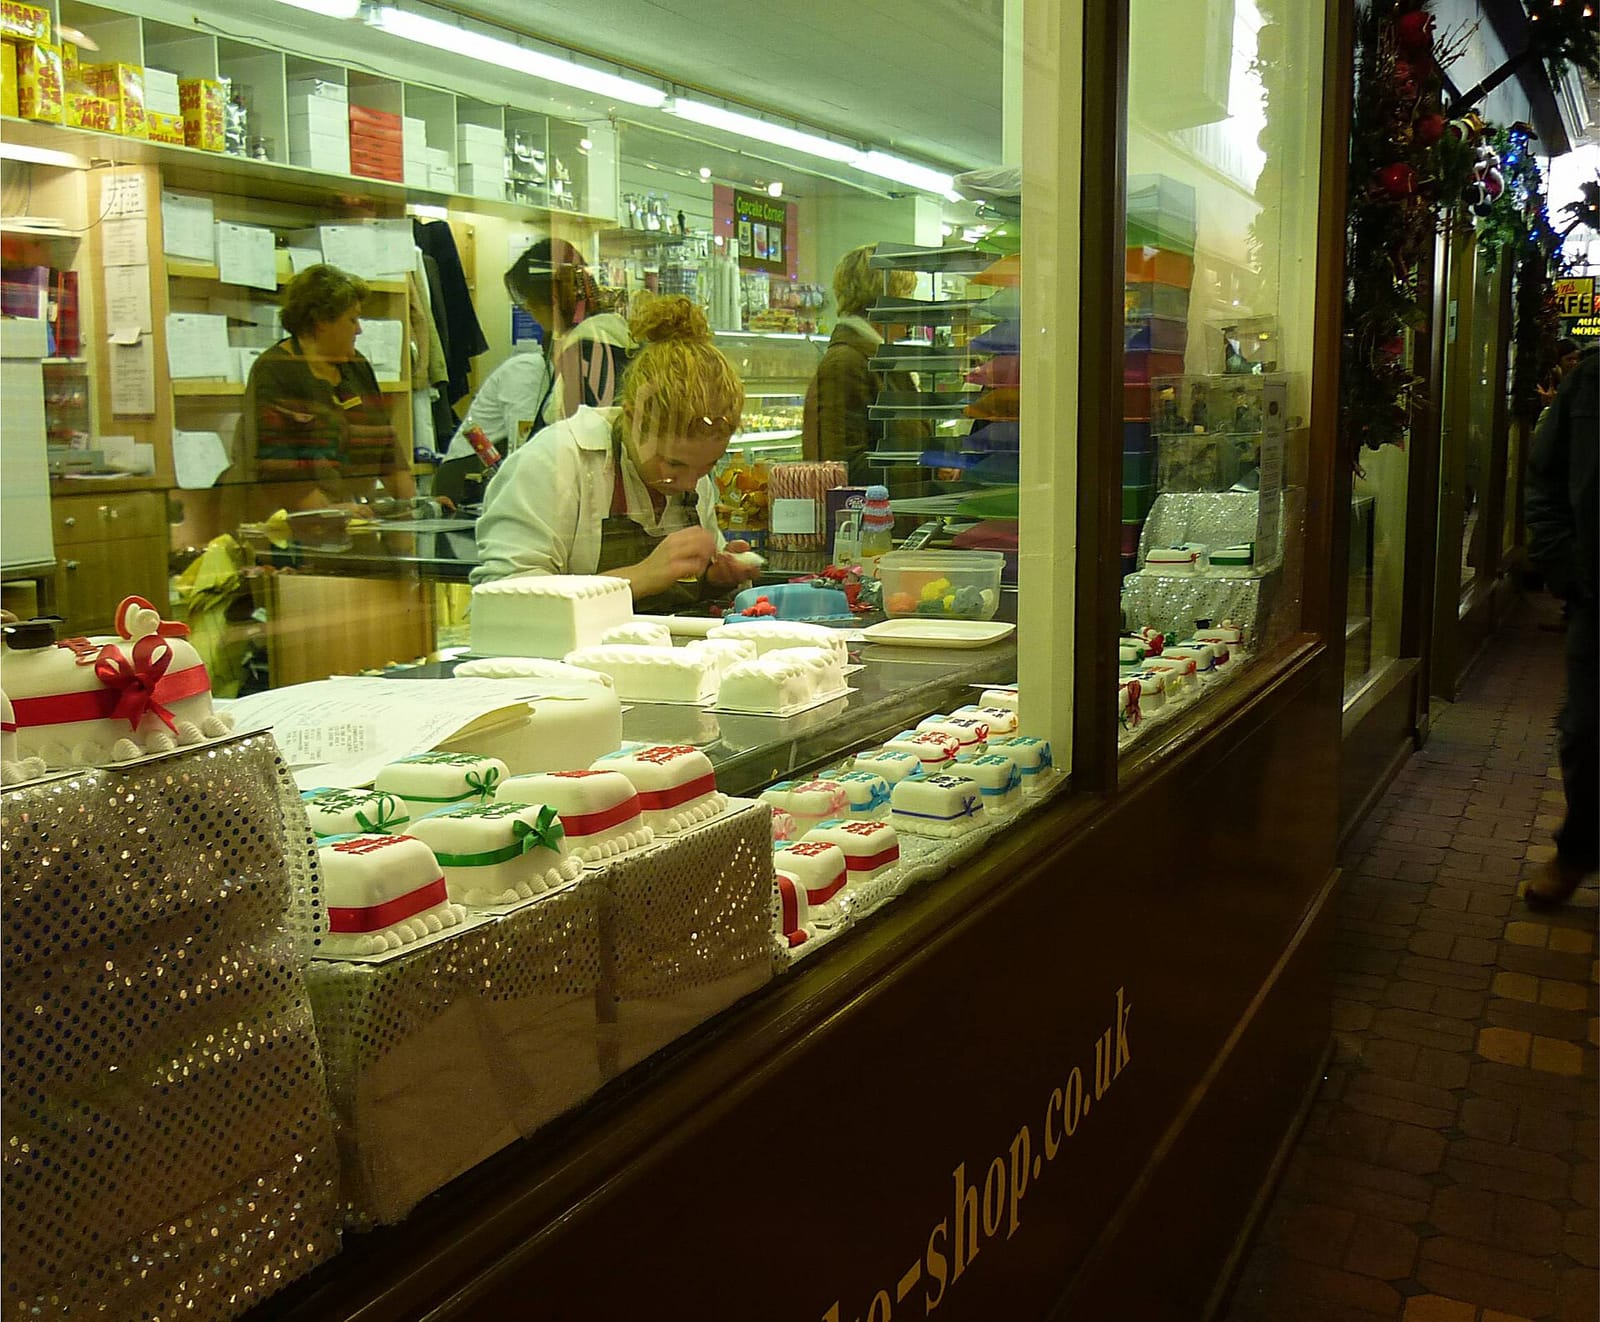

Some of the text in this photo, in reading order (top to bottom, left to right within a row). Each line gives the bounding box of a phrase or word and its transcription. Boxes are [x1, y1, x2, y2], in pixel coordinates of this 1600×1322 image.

[1, 2, 43, 21] UGAR
[74, 97, 117, 115] SUGAR
[763, 203, 784, 223] Corner
[1557, 294, 1590, 313] AFE
[821, 986, 1132, 1322] -shop.co.uk
